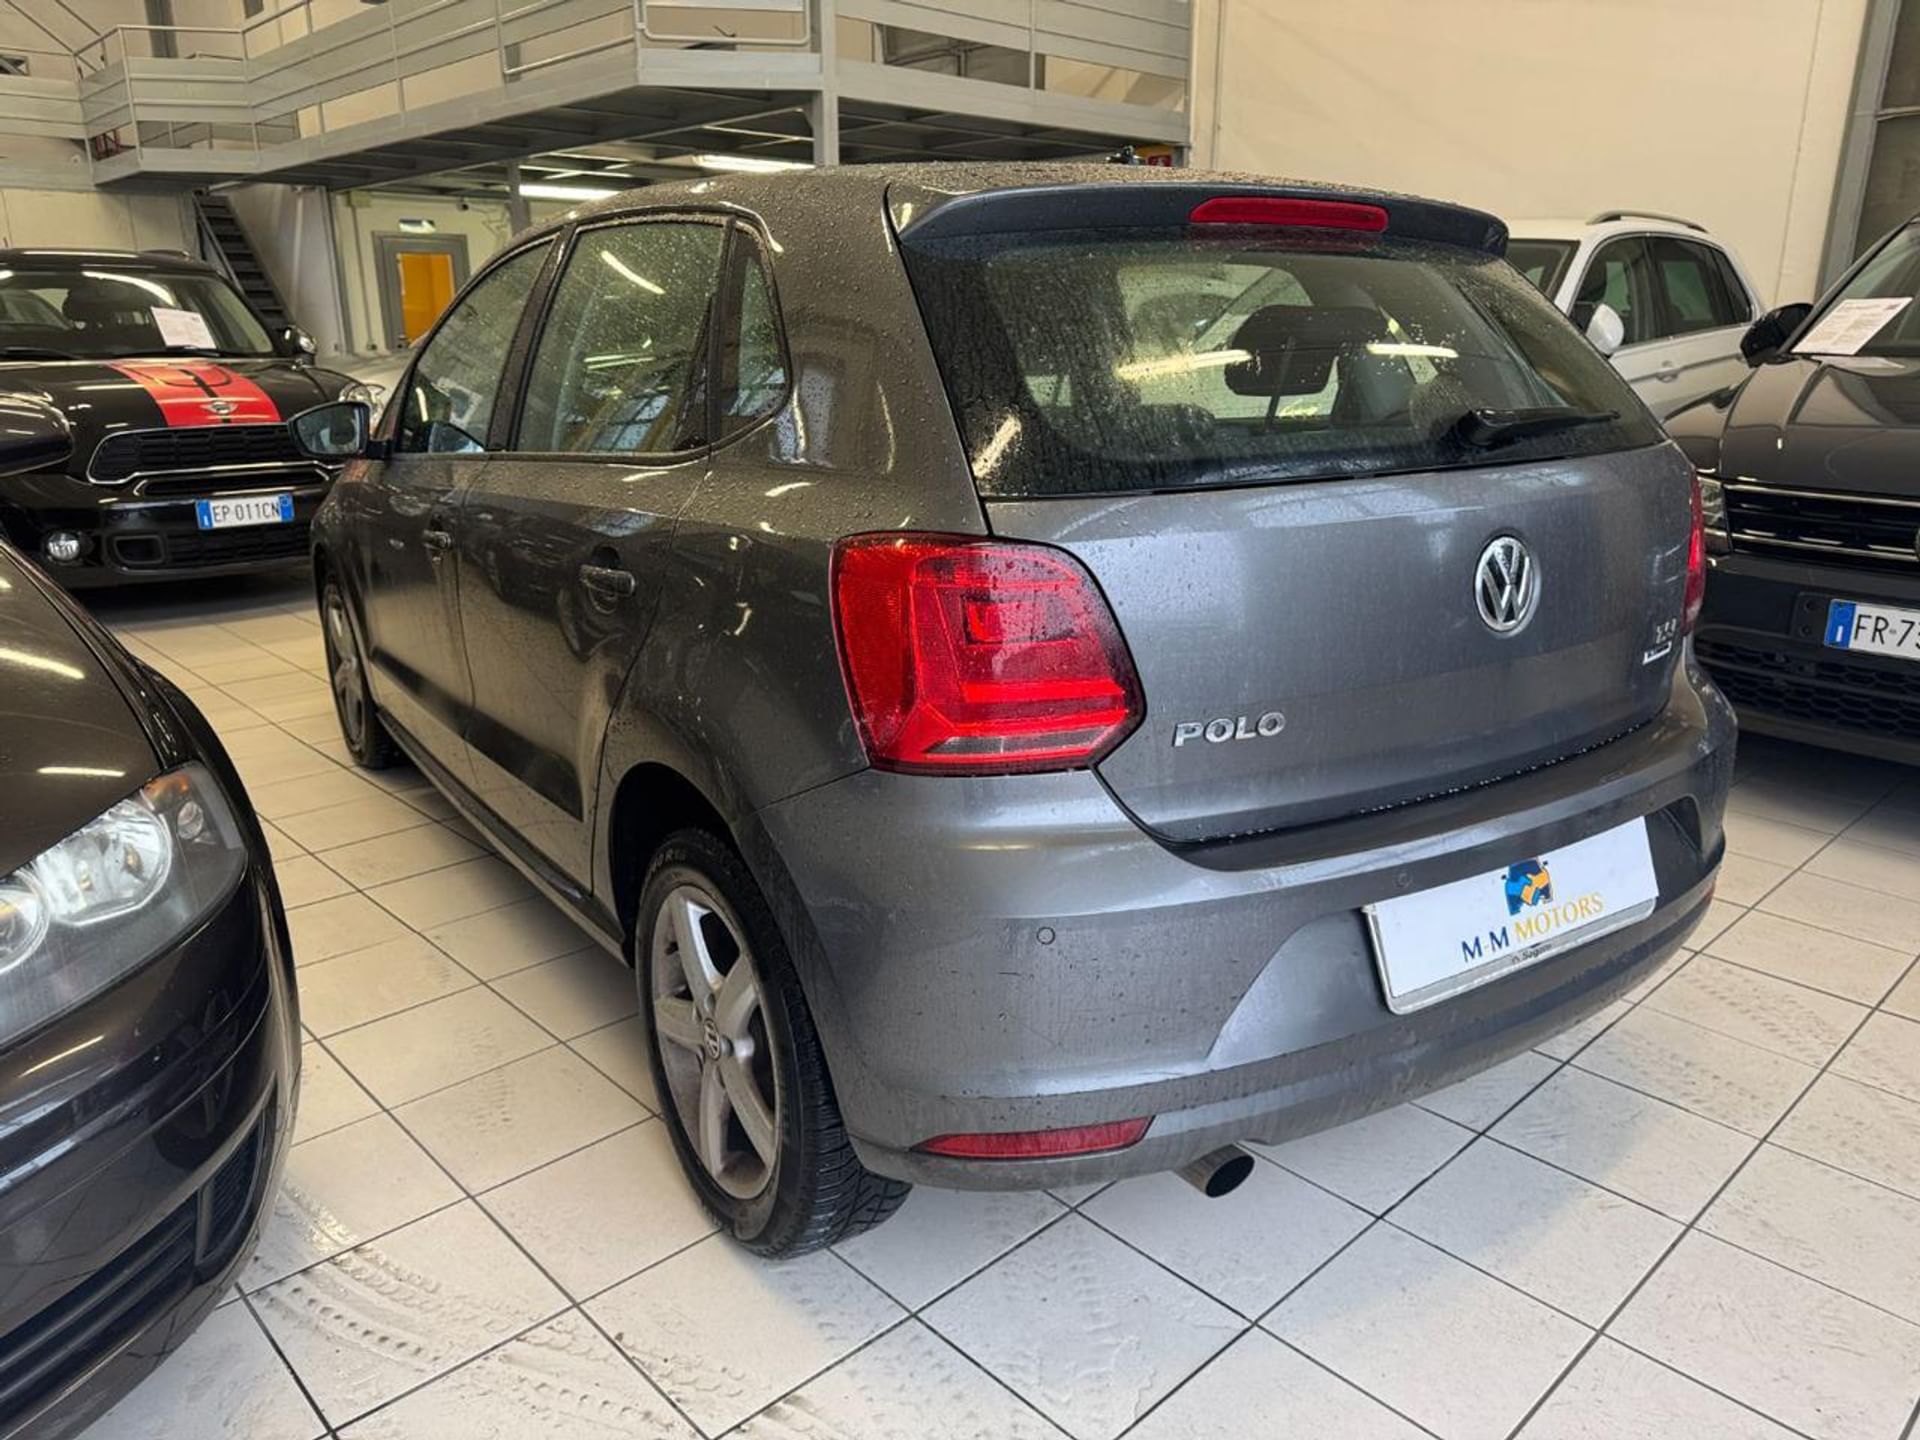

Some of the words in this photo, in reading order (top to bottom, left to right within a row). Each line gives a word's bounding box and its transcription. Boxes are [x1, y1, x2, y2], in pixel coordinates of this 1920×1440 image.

[213, 504, 230, 523] EP
[1854, 613, 1890, 645] FR
[1896, 618, 1920, 650] 7
[1173, 711, 1286, 747] POLO
[1513, 891, 1604, 943] MOTORS
